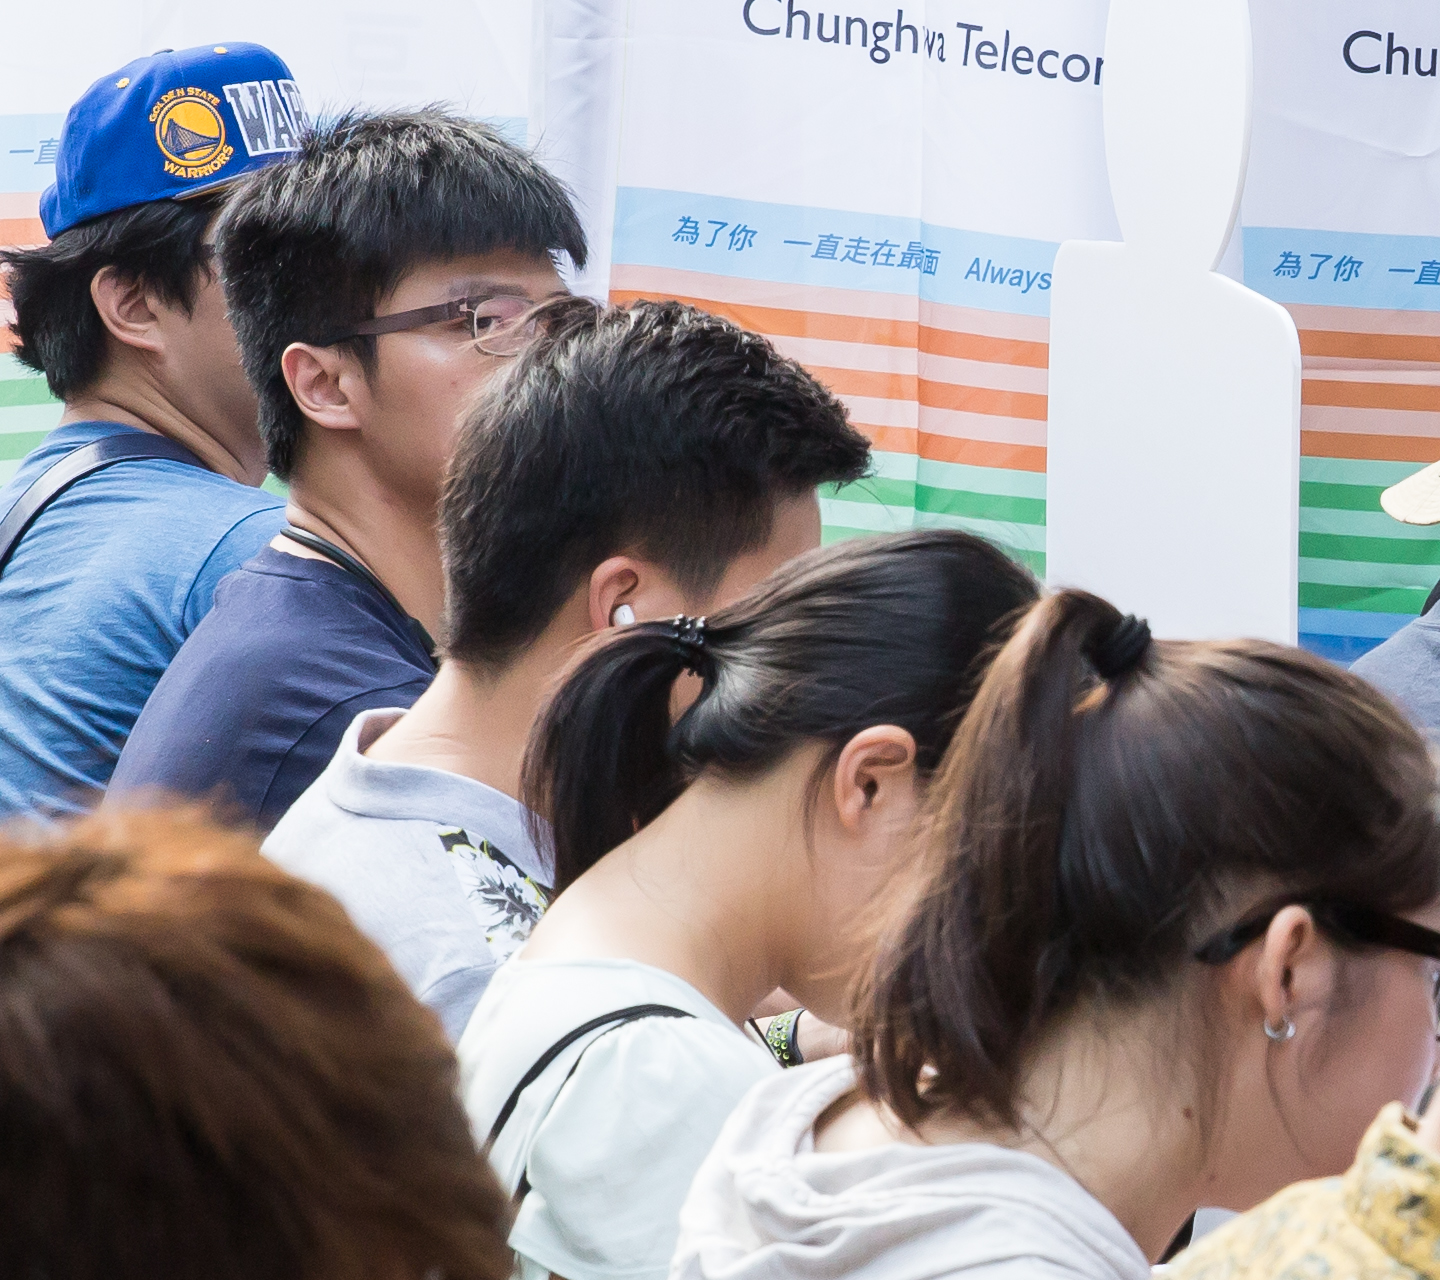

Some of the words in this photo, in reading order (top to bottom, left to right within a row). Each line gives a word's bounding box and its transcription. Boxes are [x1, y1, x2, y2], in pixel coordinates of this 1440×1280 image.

[148, 87, 185, 122] GOLDEN
[186, 86, 221, 108] STATE
[162, 145, 235, 179] WARRIORS
[672, 216, 757, 251] 為了你
[783, 234, 941, 276] 一直走在最面
[965, 258, 1052, 293] Always
[1273, 251, 1363, 281] 為了你
